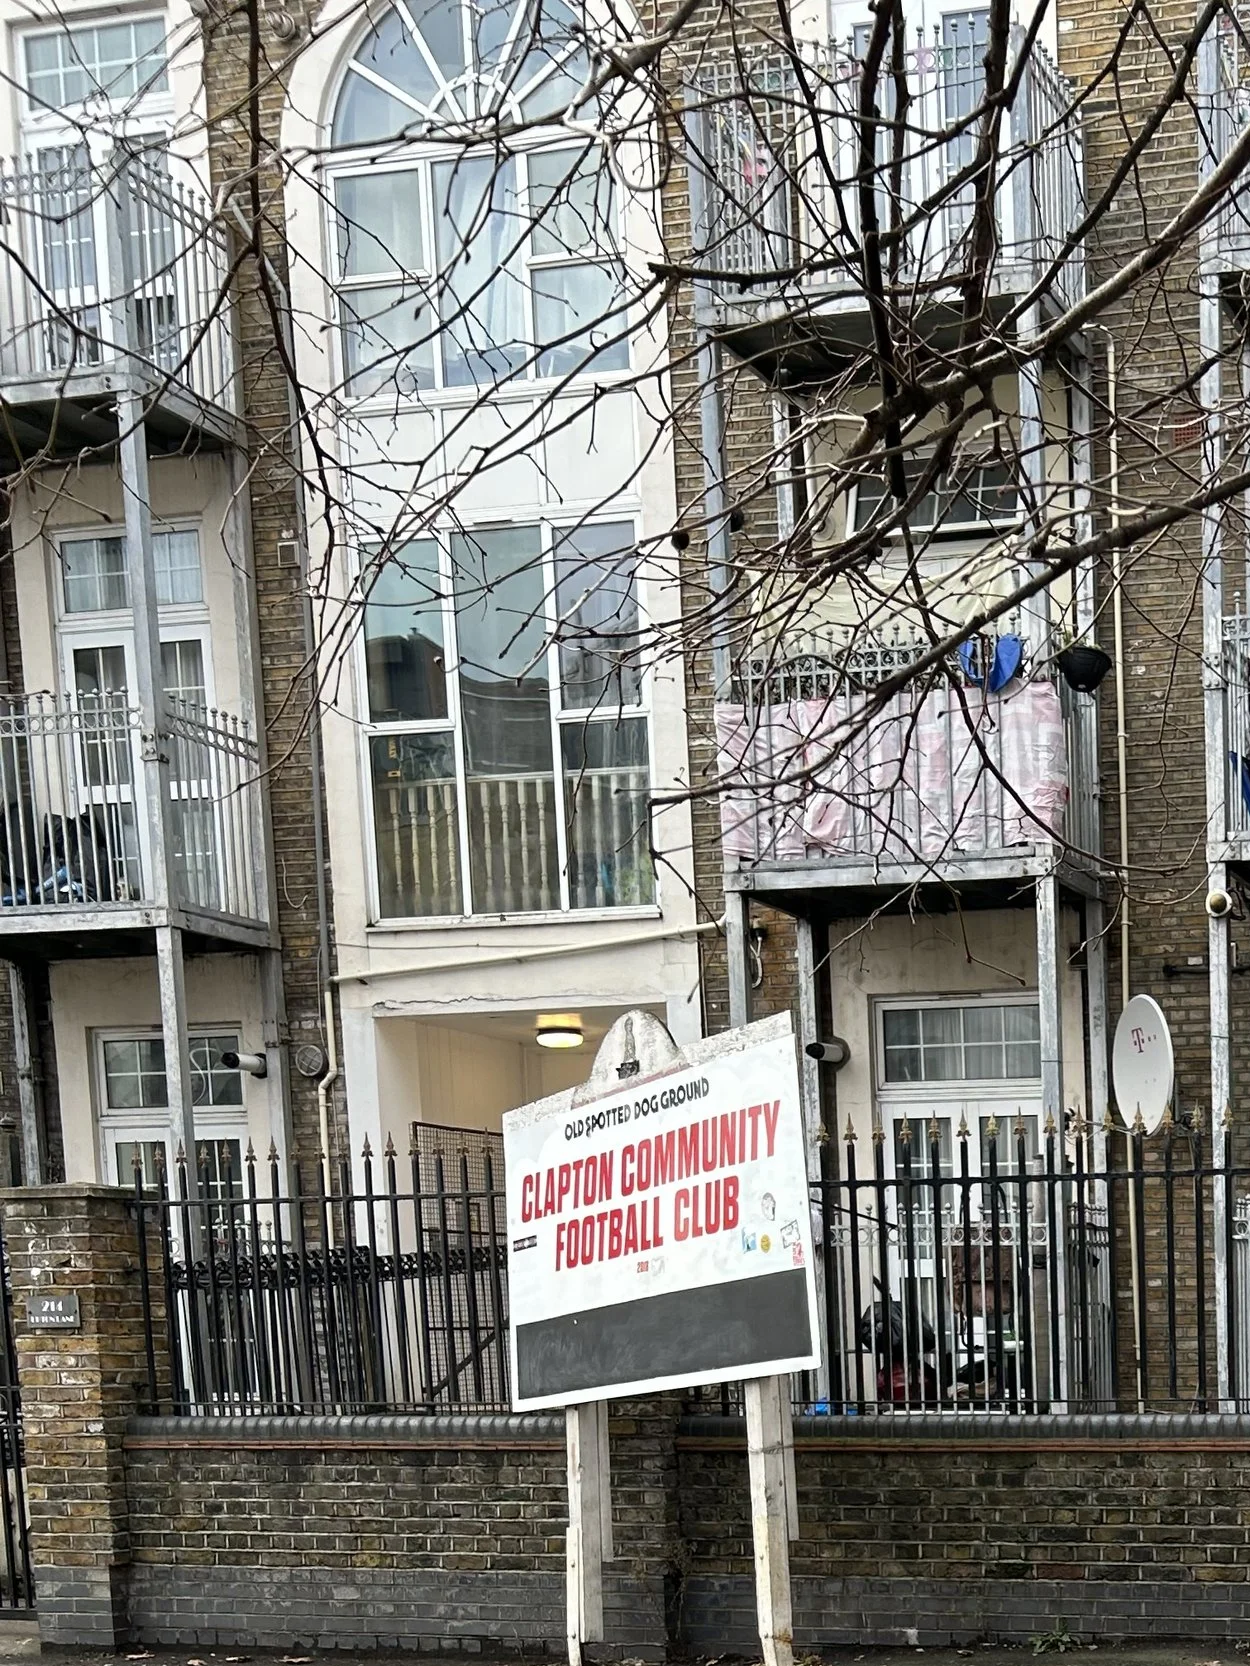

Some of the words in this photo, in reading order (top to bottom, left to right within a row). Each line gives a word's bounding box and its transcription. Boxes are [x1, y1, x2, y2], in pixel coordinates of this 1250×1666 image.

[564, 1119, 584, 1141] OLD
[585, 1104, 631, 1138] SPOTTED
[634, 1094, 659, 1120] DOG
[660, 1076, 710, 1110] GROUND
[521, 1149, 614, 1223] CLAPTON
[620, 1099, 781, 1197] COMMUNITY
[555, 1195, 664, 1272] FOOTBALL
[673, 1175, 740, 1242] CLUB
